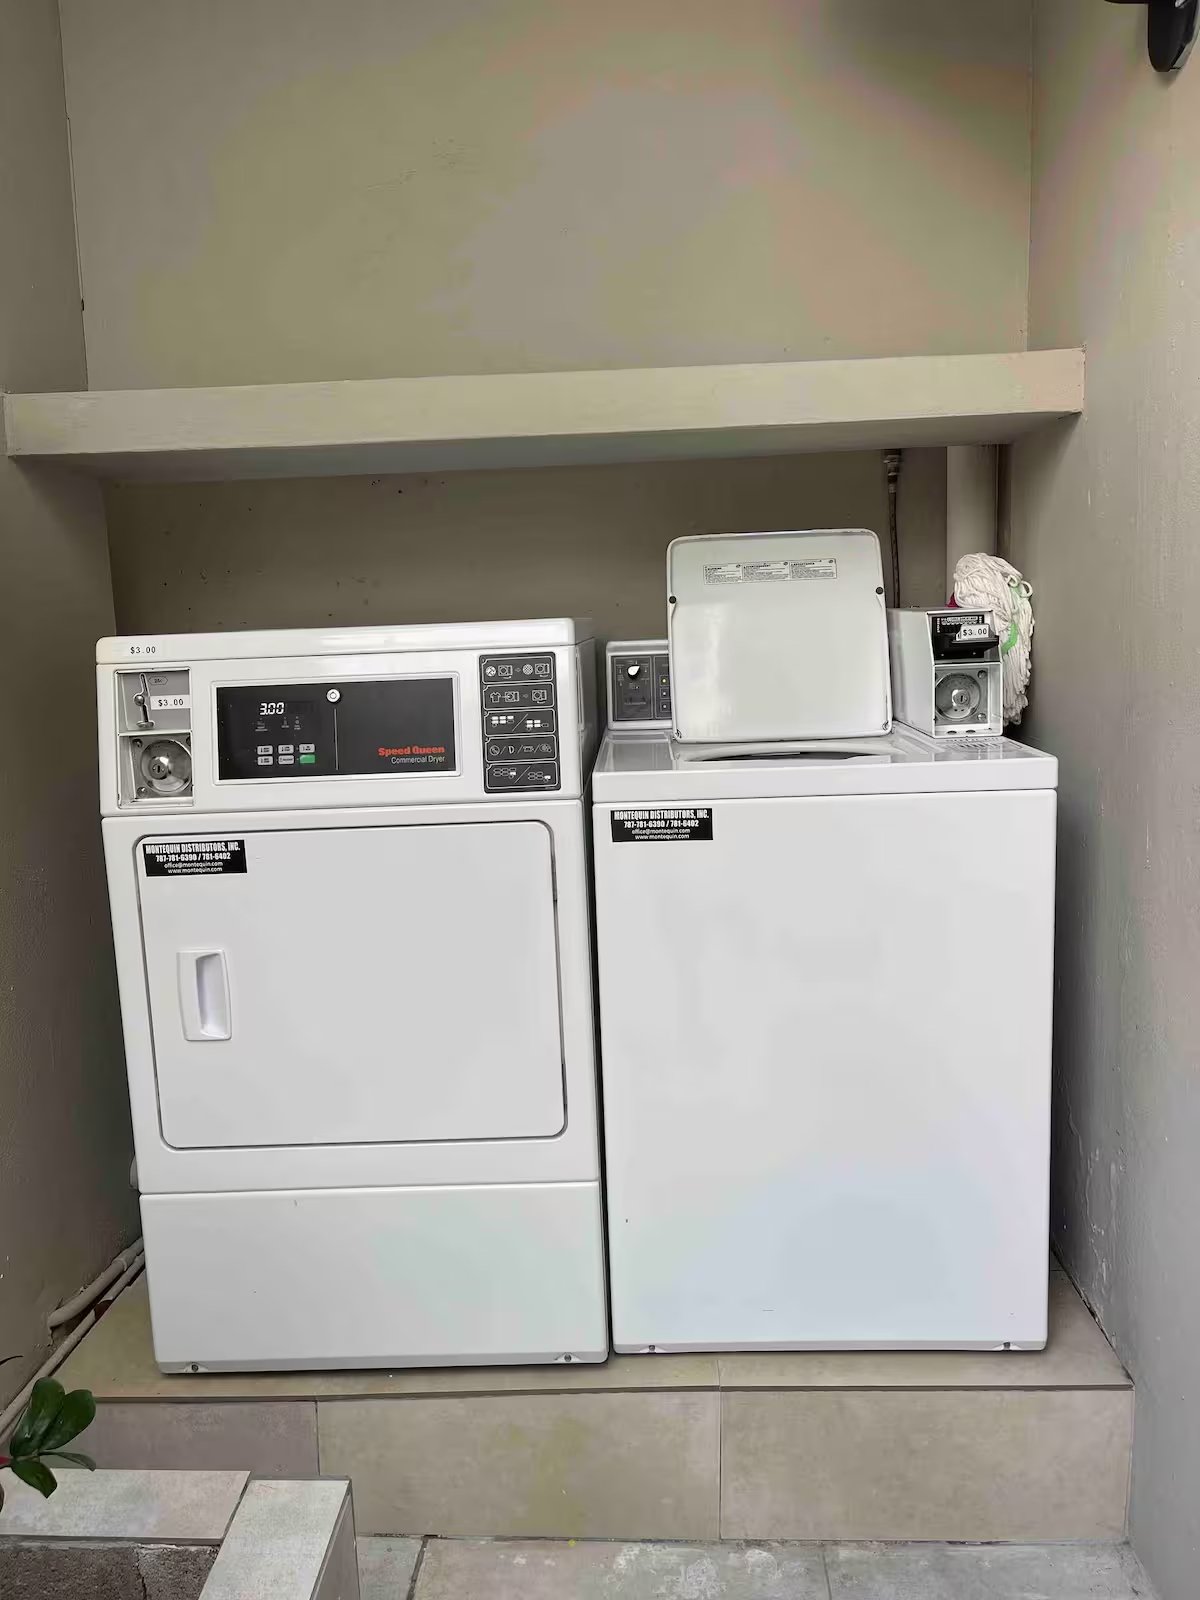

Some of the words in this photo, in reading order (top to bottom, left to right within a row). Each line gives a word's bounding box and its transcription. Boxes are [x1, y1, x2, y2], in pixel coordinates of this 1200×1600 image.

[963, 628, 987, 637] $3.00
[130, 646, 156, 655] $3.00
[158, 698, 184, 707] $3.00
[259, 702, 285, 715] 3.00
[378, 747, 411, 758] Speed
[412, 746, 445, 754] Queen
[391, 756, 427, 764] Commercial
[428, 755, 446, 764] Dryer
[614, 810, 650, 820] MONTEQUIN
[650, 810, 696, 819] DISTRIBUTORS,
[696, 809, 709, 818] INC.
[146, 844, 180, 854] MONTEQUIN
[181, 843, 227, 853] DISTRIBUTORS,
[227, 841, 241, 851] INC.
